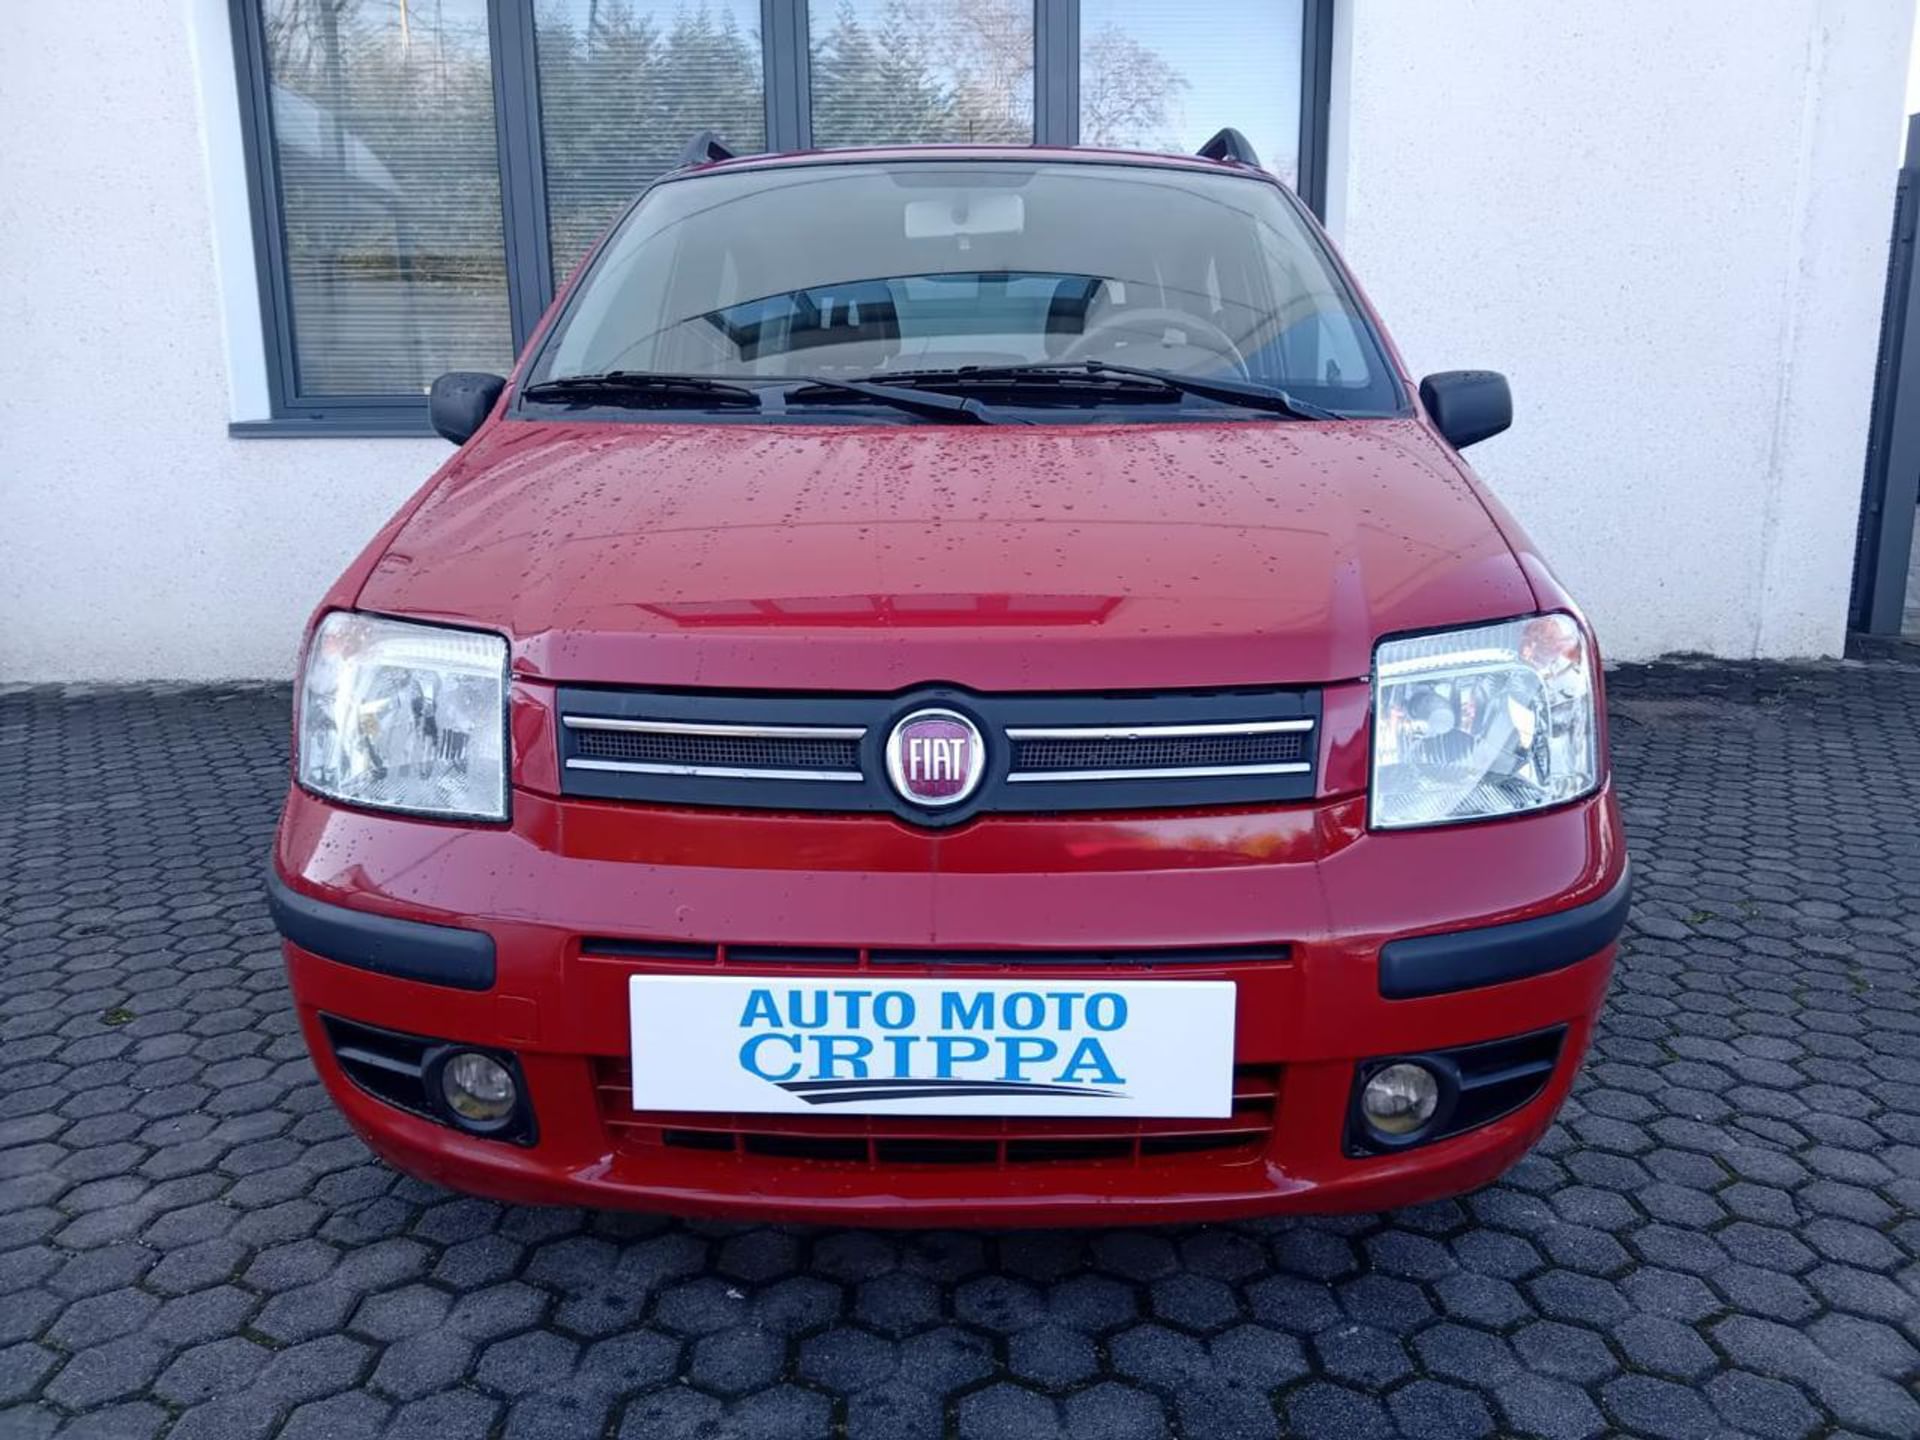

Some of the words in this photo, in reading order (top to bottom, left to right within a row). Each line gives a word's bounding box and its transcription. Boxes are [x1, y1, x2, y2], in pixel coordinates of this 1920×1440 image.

[909, 738, 965, 781] FIAT
[739, 989, 915, 1029] AUTO
[940, 991, 1129, 1031] MOTO
[738, 1033, 1127, 1084] CRIPPA
